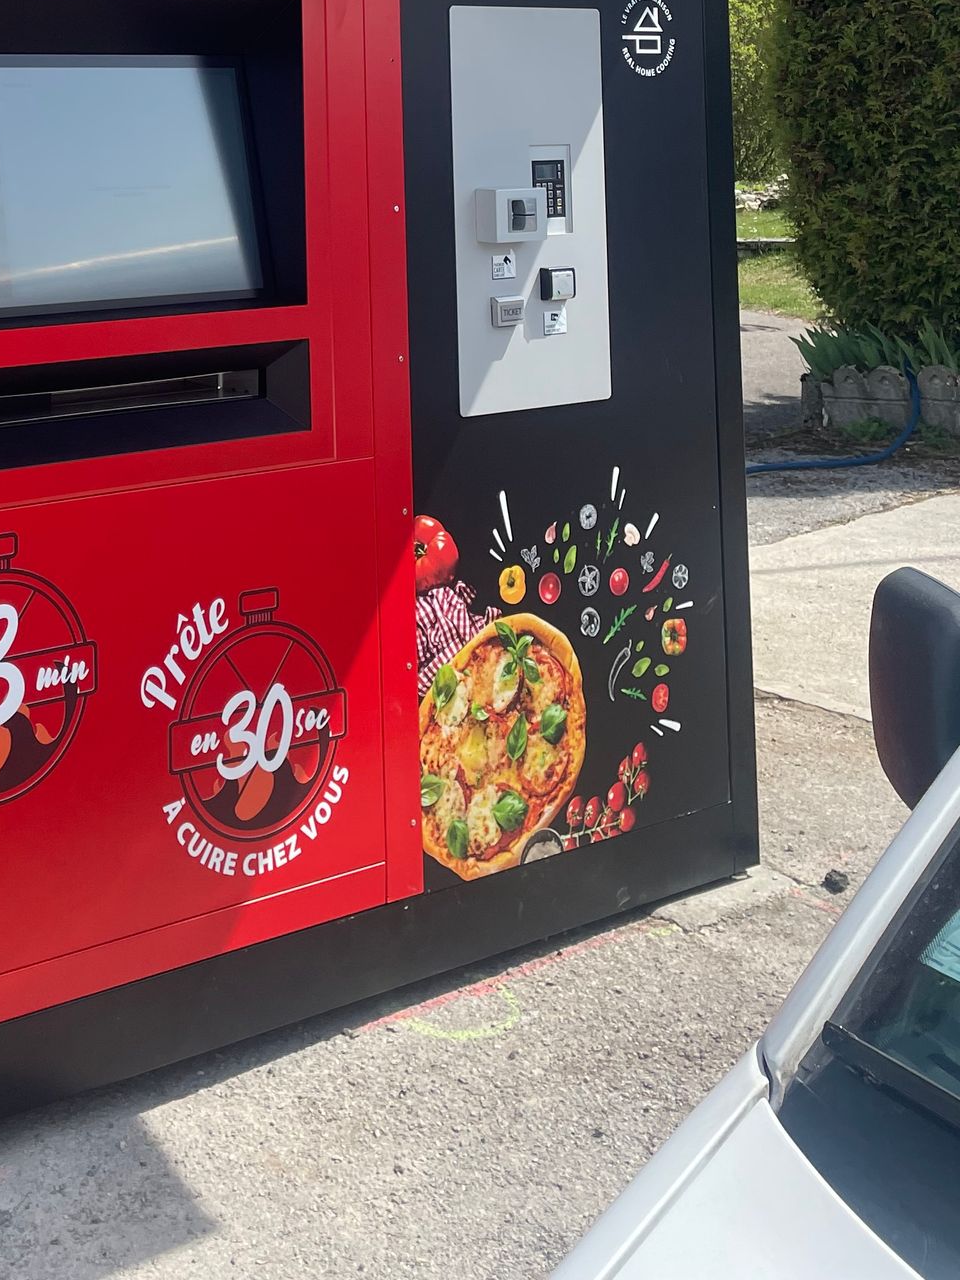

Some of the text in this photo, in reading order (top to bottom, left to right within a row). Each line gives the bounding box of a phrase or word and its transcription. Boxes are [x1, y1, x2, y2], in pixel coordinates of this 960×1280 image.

[621, 14, 628, 25] LE
[622, 38, 676, 77] REAL HOME COOKING
[35, 655, 90, 693] min
[140, 595, 231, 712] Prête
[190, 682, 332, 781] en 30 sec
[176, 821, 239, 877] CUIRE
[242, 833, 302, 877] CHEZ
[300, 764, 350, 841] VOUS
